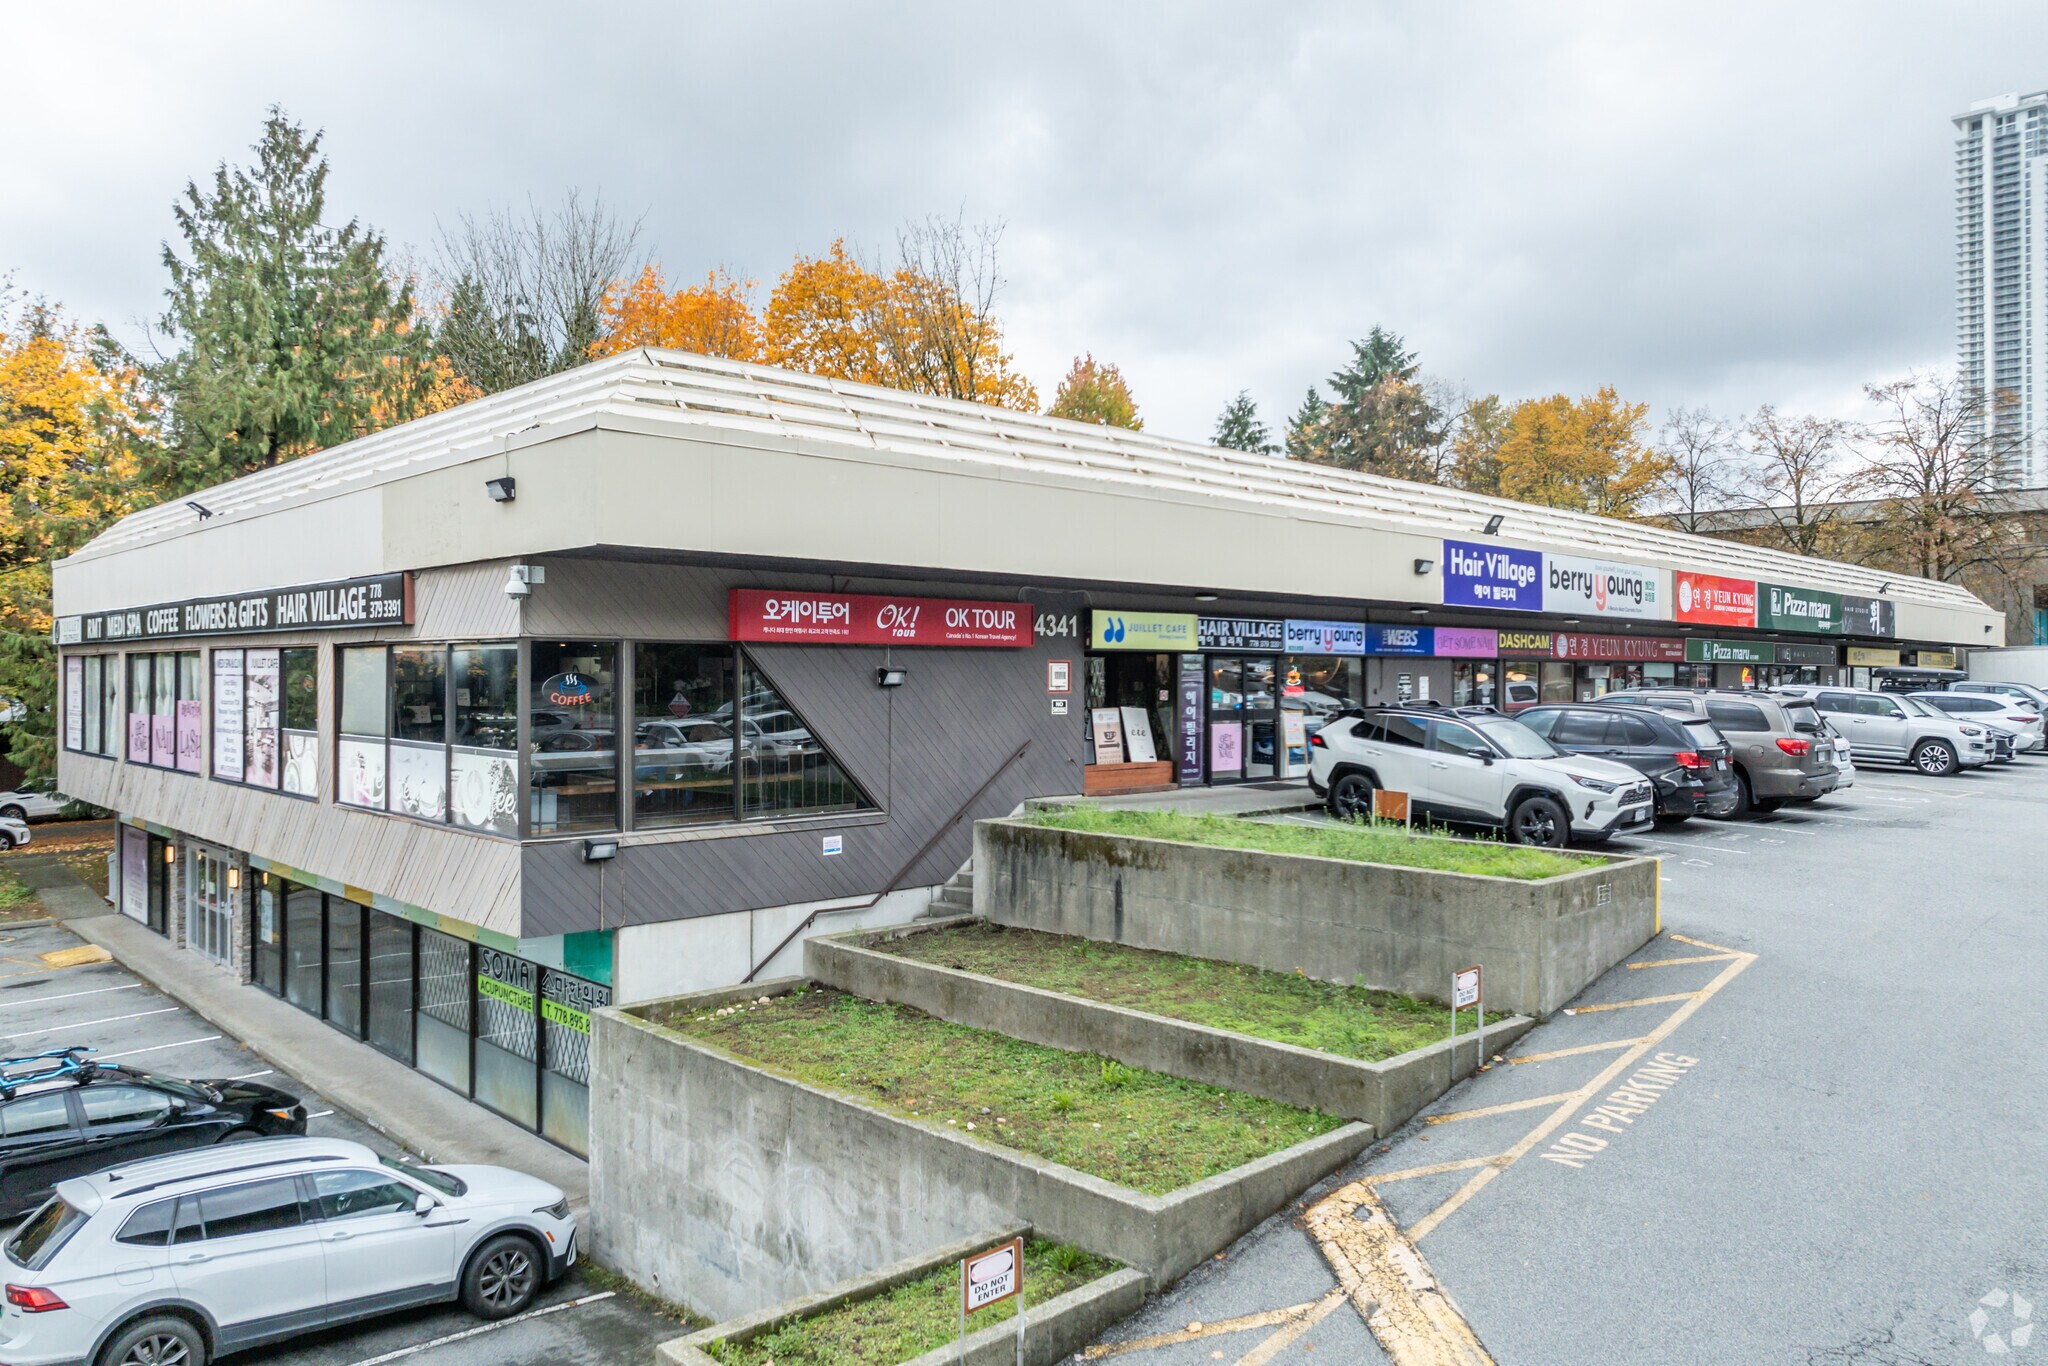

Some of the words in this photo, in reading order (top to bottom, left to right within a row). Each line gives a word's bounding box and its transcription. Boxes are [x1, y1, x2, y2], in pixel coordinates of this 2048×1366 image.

[1450, 548, 1484, 577] Hair
[1485, 552, 1536, 588] Village
[369, 584, 382, 598] 778
[1550, 560, 1592, 600] berry
[1595, 573, 1643, 612] young
[277, 592, 308, 624] HAIR
[310, 586, 367, 621] VILLAGE
[370, 601, 382, 618] 379
[383, 599, 401, 617] 3391
[1713, 590, 1731, 604] YEUN
[1732, 592, 1753, 607] KYUNG
[1784, 592, 1807, 616] Pizza
[1808, 601, 1831, 619] maru
[147, 608, 179, 634] COFFEE
[185, 602, 227, 630] FLOWERS
[227, 601, 237, 626] &
[239, 598, 268, 627] GIFTS
[763, 599, 850, 625] 오케이투어
[876, 604, 920, 629] OK!
[945, 608, 970, 628] OK
[972, 609, 1016, 629] TOUR
[87, 617, 102, 639] RMT
[107, 613, 126, 637] MEDI
[126, 611, 142, 636] SPA
[892, 629, 916, 638] TOUR
[1034, 614, 1078, 637] 4341
[1128, 623, 1163, 633] JUILLET
[1166, 624, 1187, 634] CAFE
[1197, 620, 1230, 636] HAIR
[1232, 621, 1282, 638] VILLAGE
[1288, 624, 1321, 645] berry
[1324, 629, 1363, 652] young
[1387, 629, 1418, 646] WEBS
[1455, 637, 1476, 650] SOME
[1498, 633, 1550, 649] DASHCAM
[1592, 638, 1620, 656] YEUN
[1624, 640, 1658, 658] KYUNG
[1712, 643, 1731, 659] Pizza
[1732, 648, 1750, 660] maru
[550, 692, 592, 706] COFFEE
[483, 950, 529, 990] SOMA
[480, 981, 532, 1011] ACUPUNCTURE
[554, 1006, 583, 1030] 778.895
[1540, 1132, 1609, 1169] NO
[1581, 1052, 1700, 1134] PARKING
[974, 1283, 988, 1294] DO
[990, 1274, 1009, 1287] NOT
[978, 1284, 1006, 1302] ENTER
